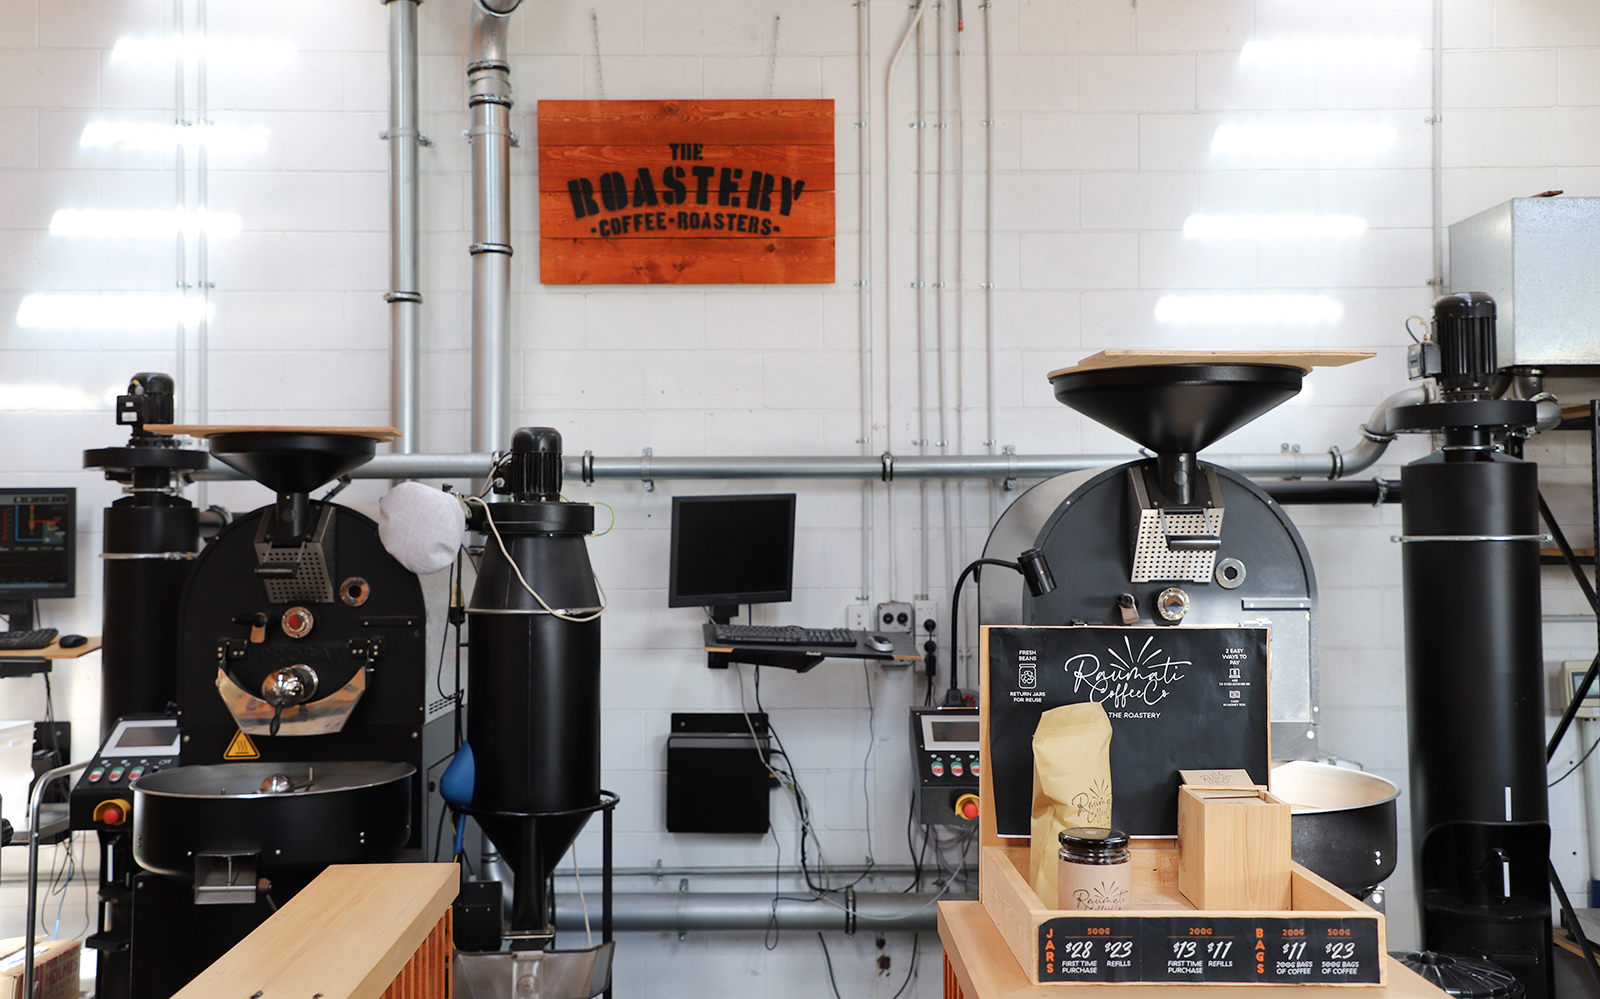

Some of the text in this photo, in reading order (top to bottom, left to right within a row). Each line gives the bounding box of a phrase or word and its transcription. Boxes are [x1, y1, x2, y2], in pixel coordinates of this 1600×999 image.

[669, 143, 703, 161] THE
[567, 166, 806, 218] ROASTERY
[1064, 653, 1192, 693] Raumati
[1327, 928, 1351, 936] 500G
[1045, 928, 1055, 974] JARS
[1065, 941, 1093, 959] $28
[1104, 941, 1133, 959] $23
[1173, 941, 1197, 959] $13
[1207, 941, 1233, 959] $11
[1255, 928, 1266, 974] BAGS
[1282, 942, 1307, 960] $11
[1325, 942, 1355, 960] $23
